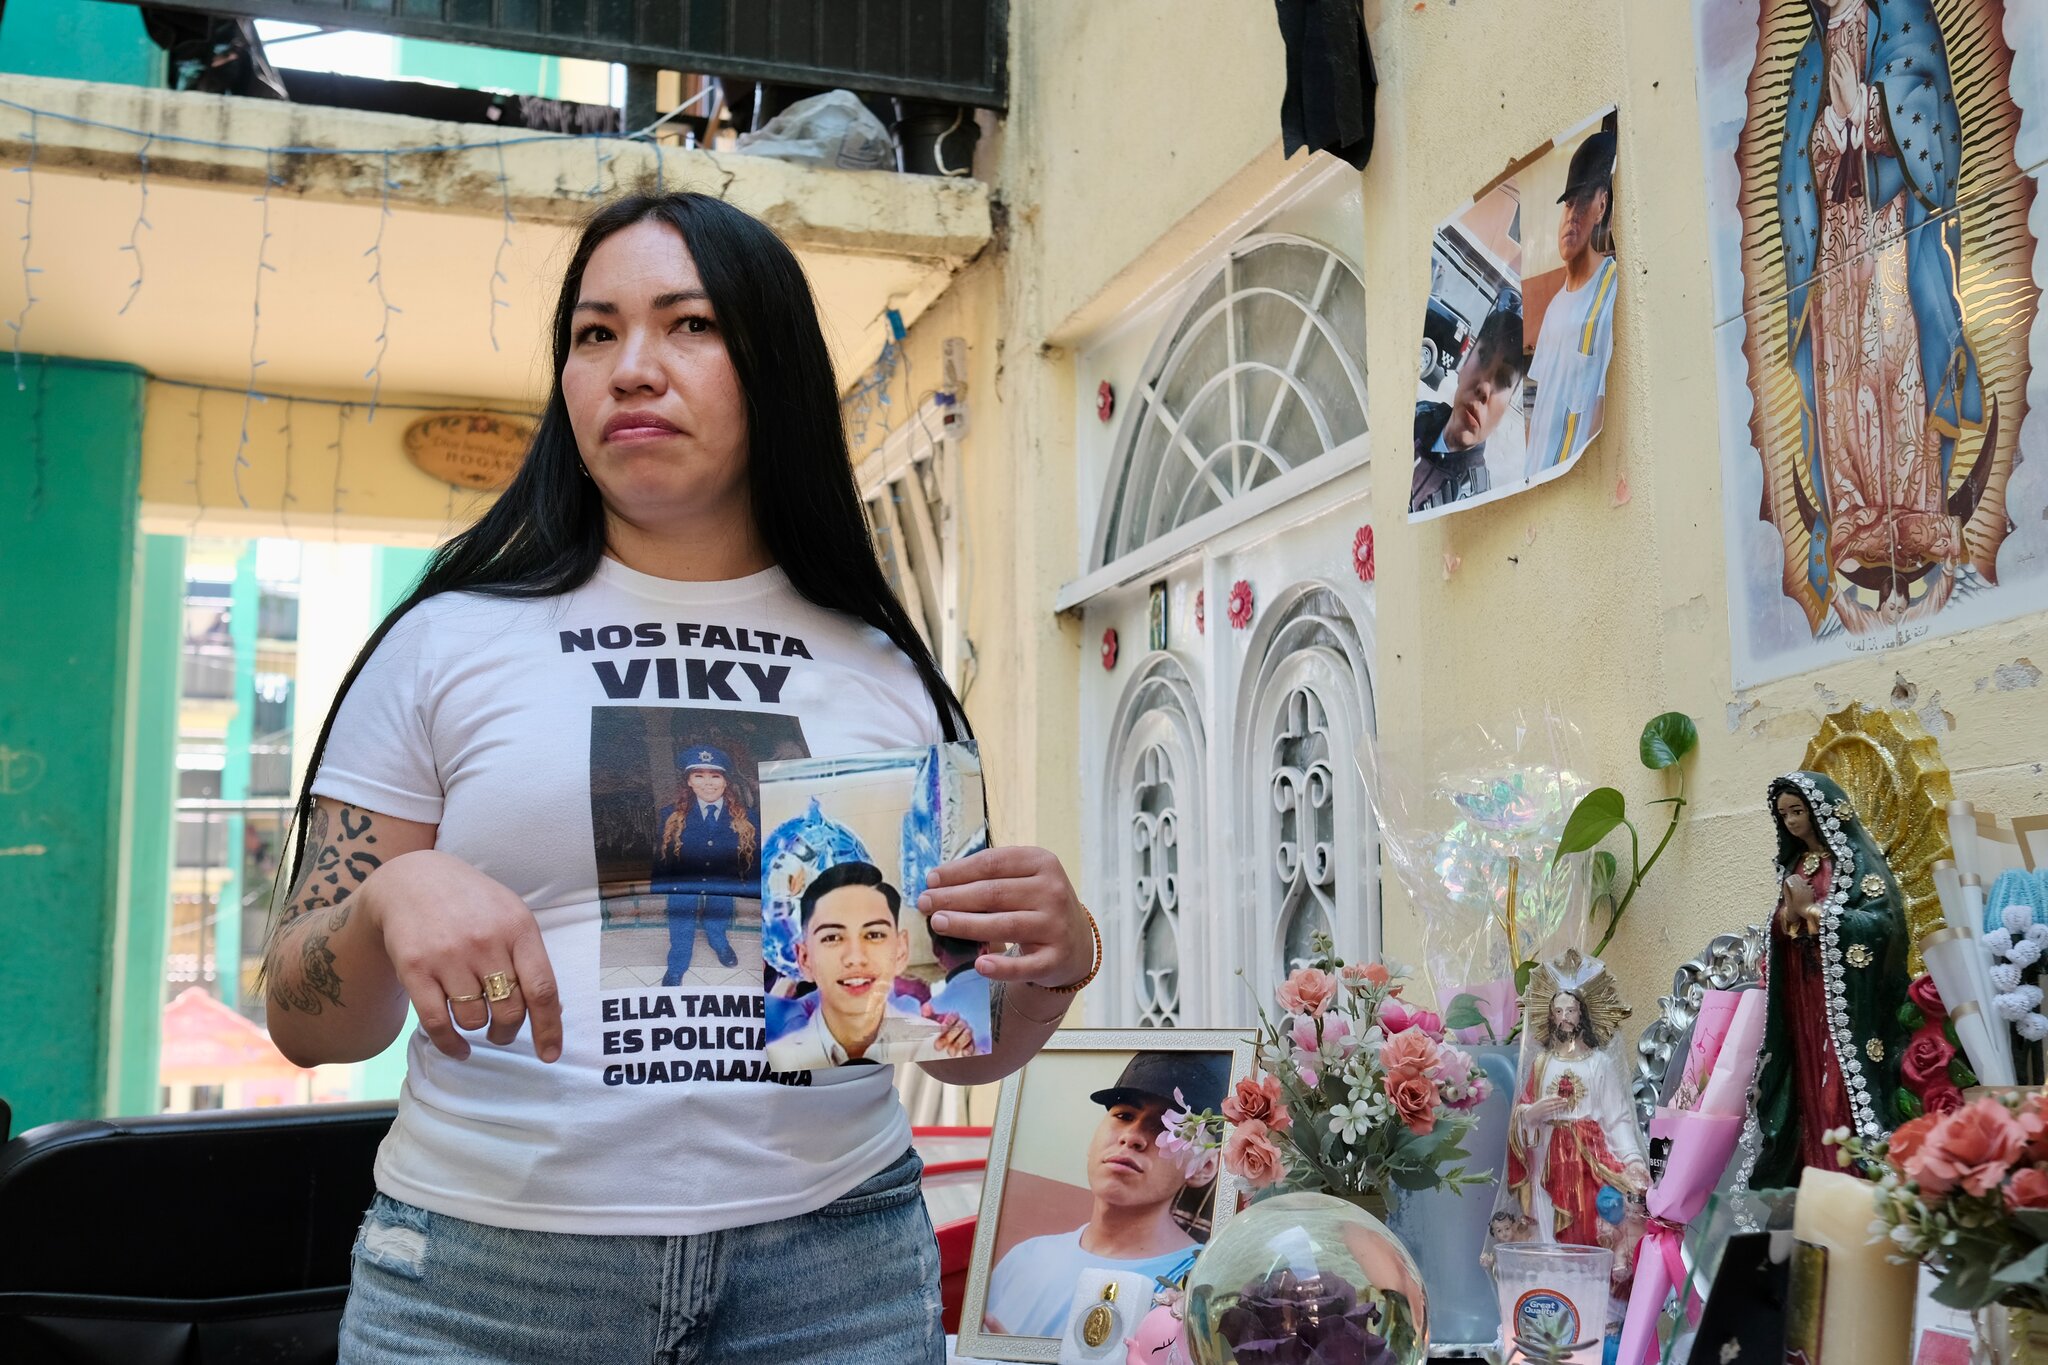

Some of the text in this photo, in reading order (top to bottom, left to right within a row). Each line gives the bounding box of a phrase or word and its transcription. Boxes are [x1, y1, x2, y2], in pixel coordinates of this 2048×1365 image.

[560, 623, 814, 661] NOS FALTA
[592, 658, 791, 704] VIKY
[602, 995, 676, 1023] ELLA
[604, 1029, 644, 1056] ES
[1524, 1306, 1556, 1316] Quality
[1530, 1301, 1556, 1310] Great
